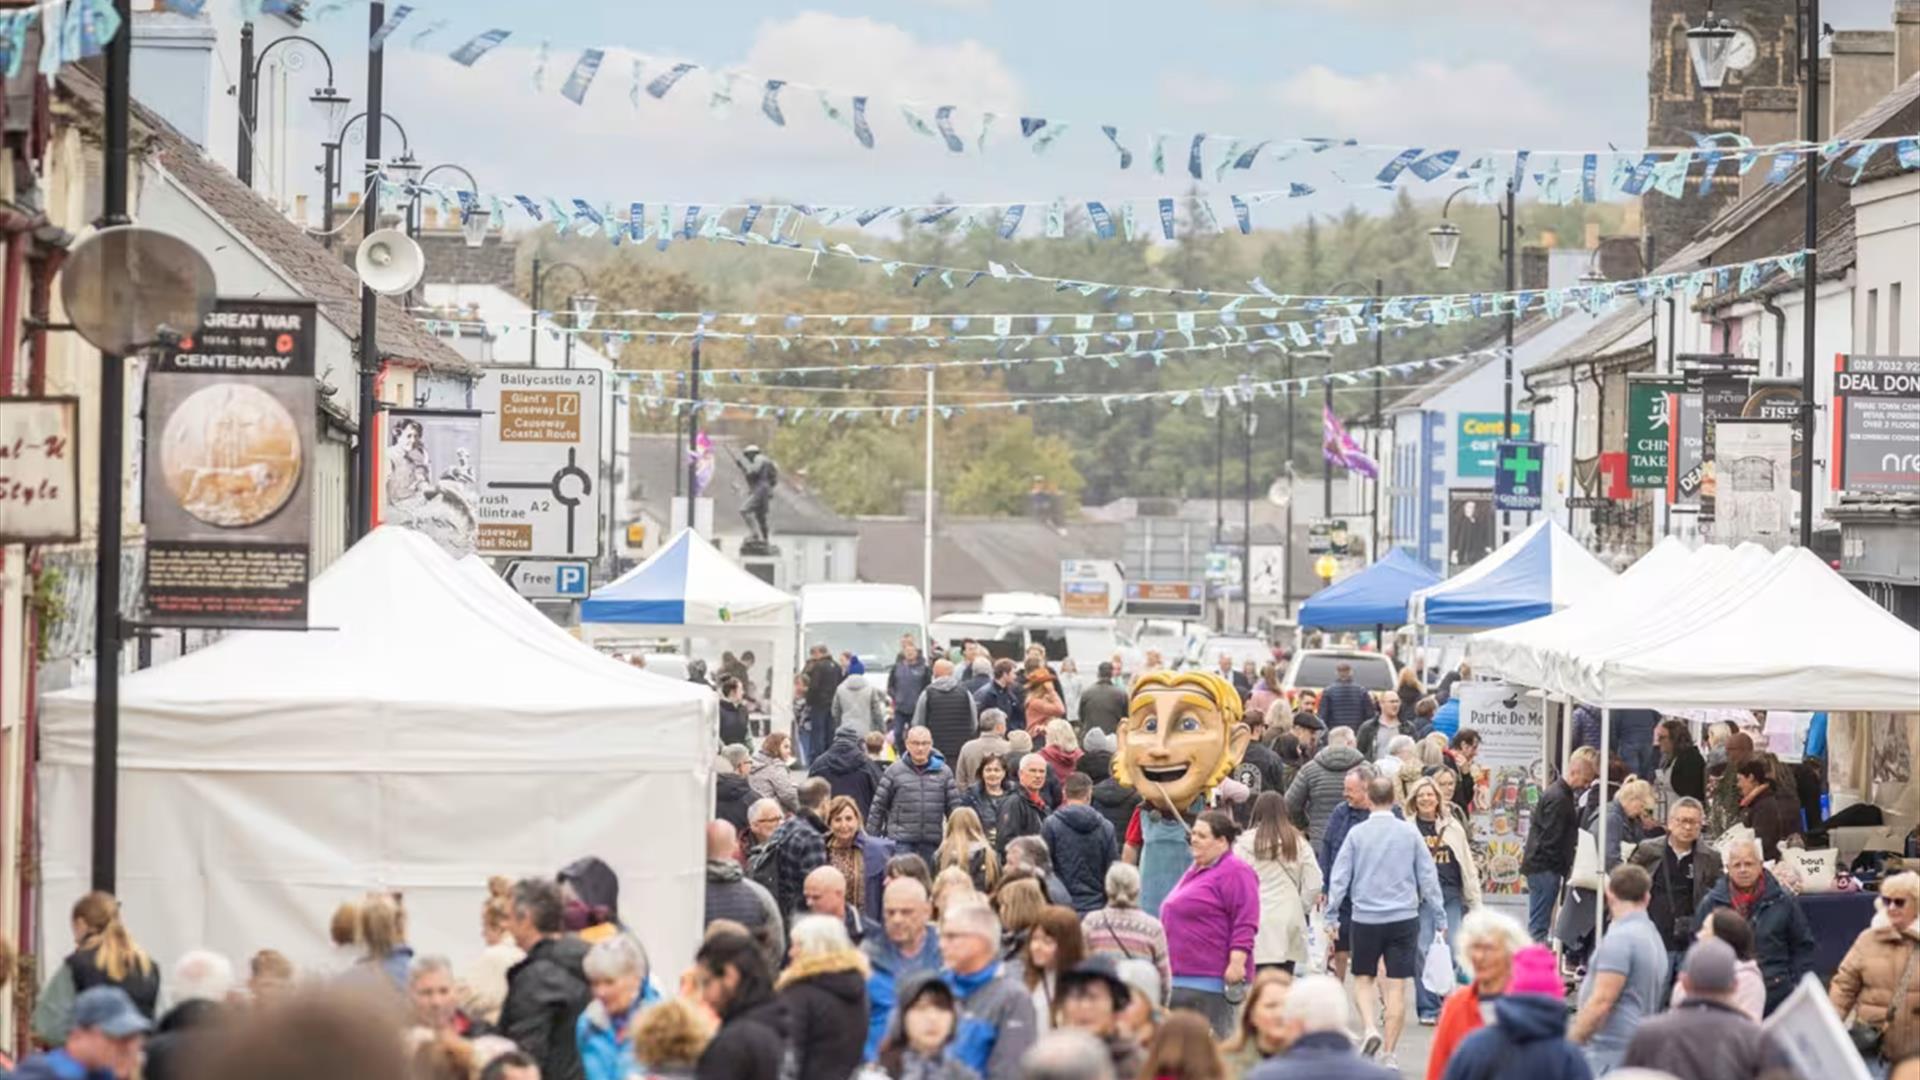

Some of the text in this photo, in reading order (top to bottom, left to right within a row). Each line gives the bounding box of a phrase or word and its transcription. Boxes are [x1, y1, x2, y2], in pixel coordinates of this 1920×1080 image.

[204, 313, 259, 329] GREAT
[261, 315, 301, 330] WAR
[174, 353, 291, 370] CENTENARY
[1853, 360, 1874, 371] 028
[1877, 360, 1903, 371] 7032
[501, 373, 572, 387] Ballycastle
[1839, 373, 1880, 391] DEAL
[512, 392, 547, 405] Giant's
[503, 404, 555, 417] Causeway
[1761, 406, 1800, 419] FISH
[514, 418, 567, 430] Causeway
[502, 428, 577, 440] Coastal Route
[499, 536, 529, 548] Route
[522, 572, 552, 584] Free
[1471, 710, 1507, 725] Partie
[1510, 711, 1526, 725] De
[1808, 866, 1820, 874] ye
